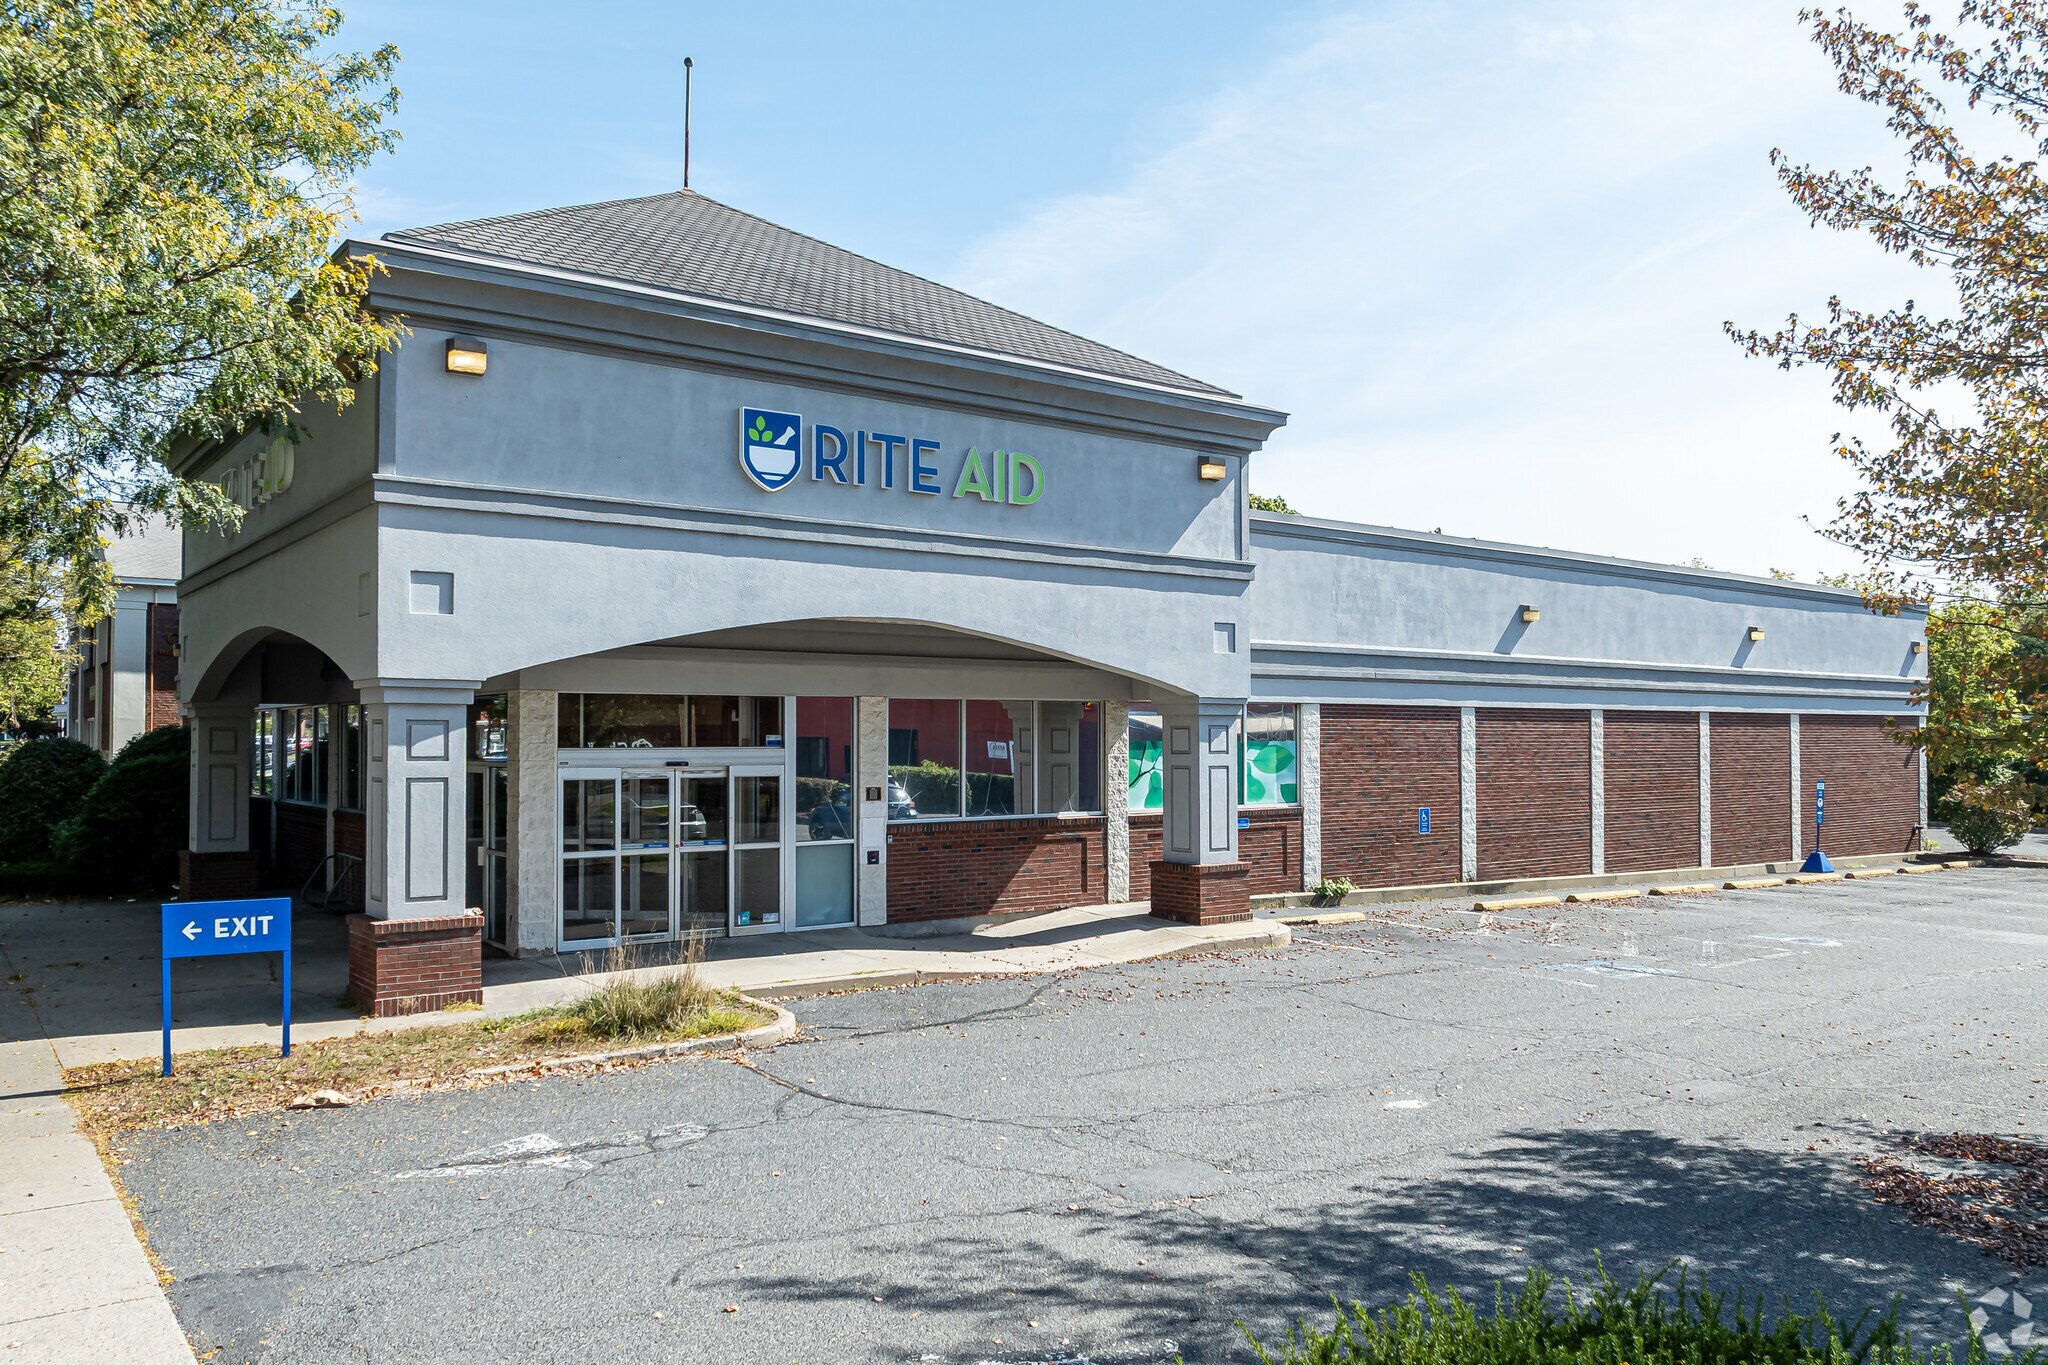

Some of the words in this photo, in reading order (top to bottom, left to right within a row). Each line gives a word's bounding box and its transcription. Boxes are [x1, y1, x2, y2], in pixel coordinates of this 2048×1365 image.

[811, 424, 942, 494] RITE
[952, 446, 1046, 505] AID
[214, 915, 274, 938] EXIT
